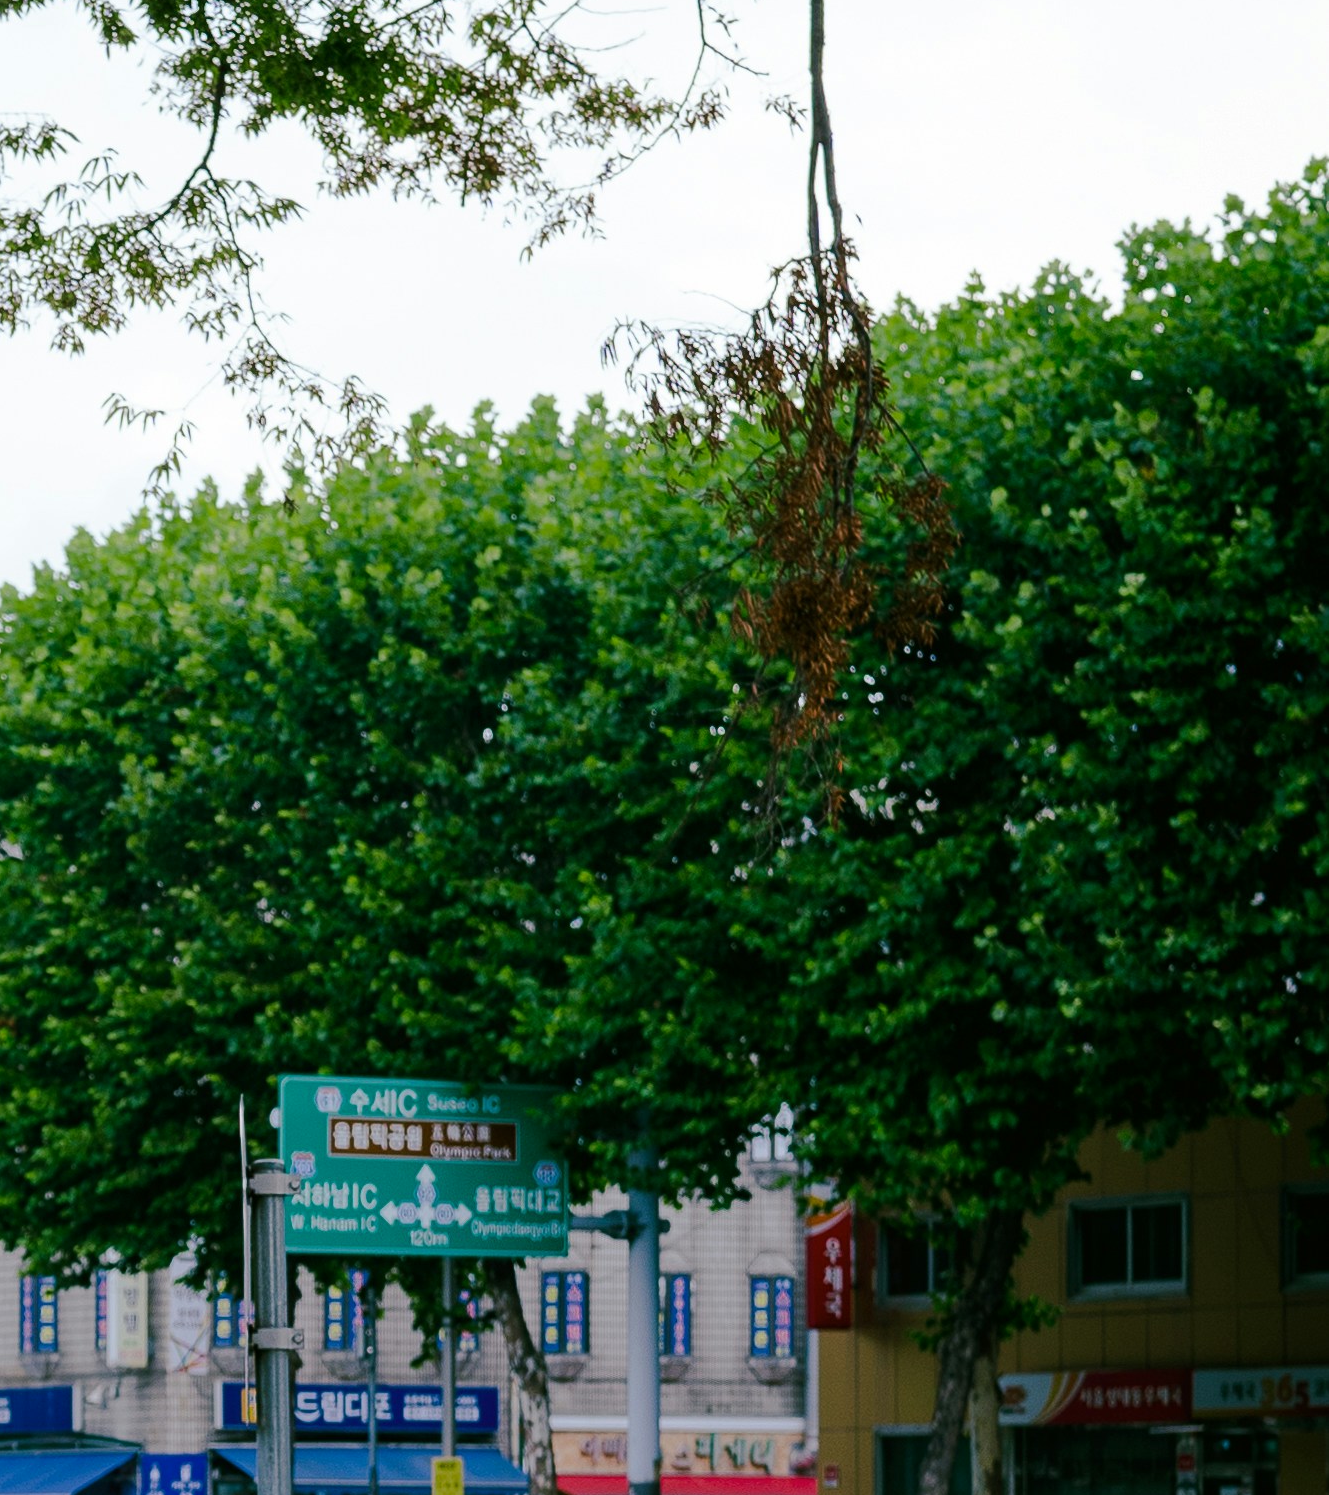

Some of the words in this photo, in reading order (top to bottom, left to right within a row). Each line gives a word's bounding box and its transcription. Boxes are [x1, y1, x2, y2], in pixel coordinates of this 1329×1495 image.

[482, 1095, 501, 1114] IC
[333, 1121, 422, 1151] 올림픽공원
[429, 1142, 482, 1161] Olympic
[484, 1145, 512, 1160] Park
[292, 1182, 378, 1209] 서하남IC
[476, 1186, 560, 1213] 올림픽대교
[361, 1216, 377, 1232] IC
[410, 1230, 448, 1246] 120m
[824, 1237, 842, 1319] 우체국
[1260, 1372, 1310, 1409] 365
[294, 1391, 392, 1423] 드림디포
